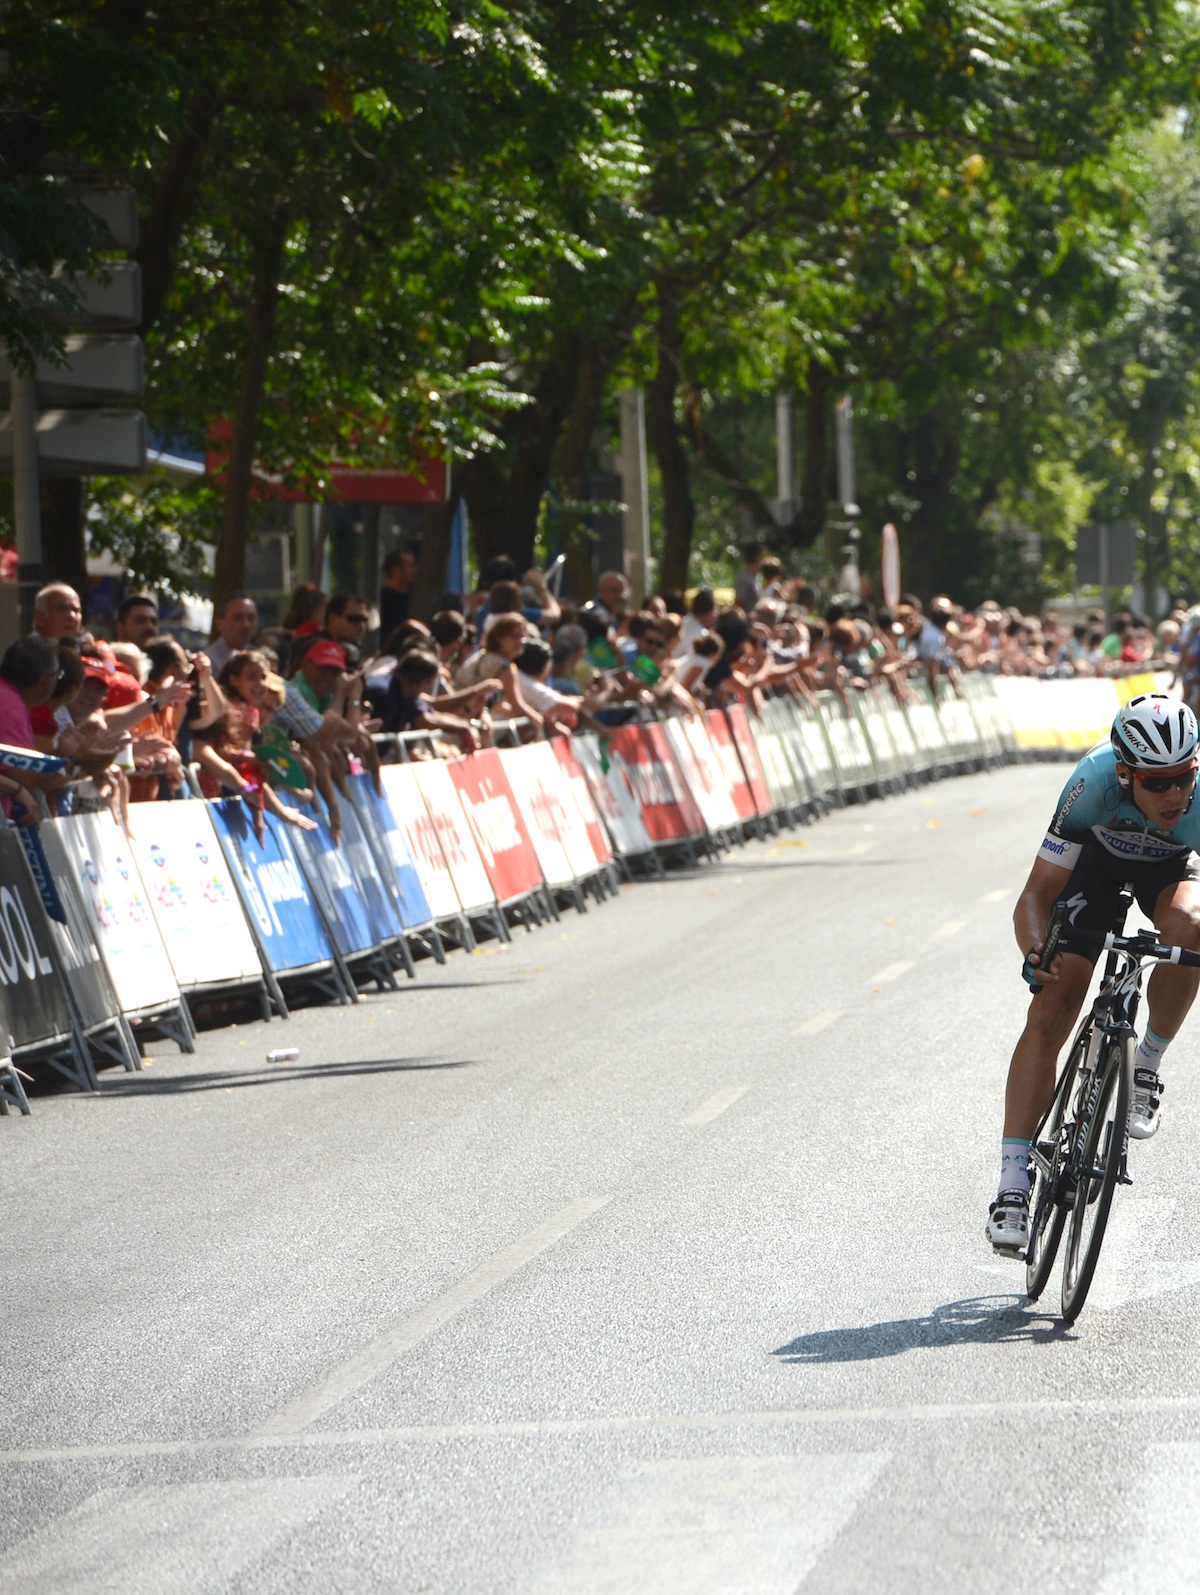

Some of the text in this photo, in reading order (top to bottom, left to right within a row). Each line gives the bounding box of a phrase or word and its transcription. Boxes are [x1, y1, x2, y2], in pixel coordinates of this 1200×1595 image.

[1042, 838, 1064, 856] anom
[1104, 833, 1142, 853] QUICK
[0, 885, 53, 986] OOL
